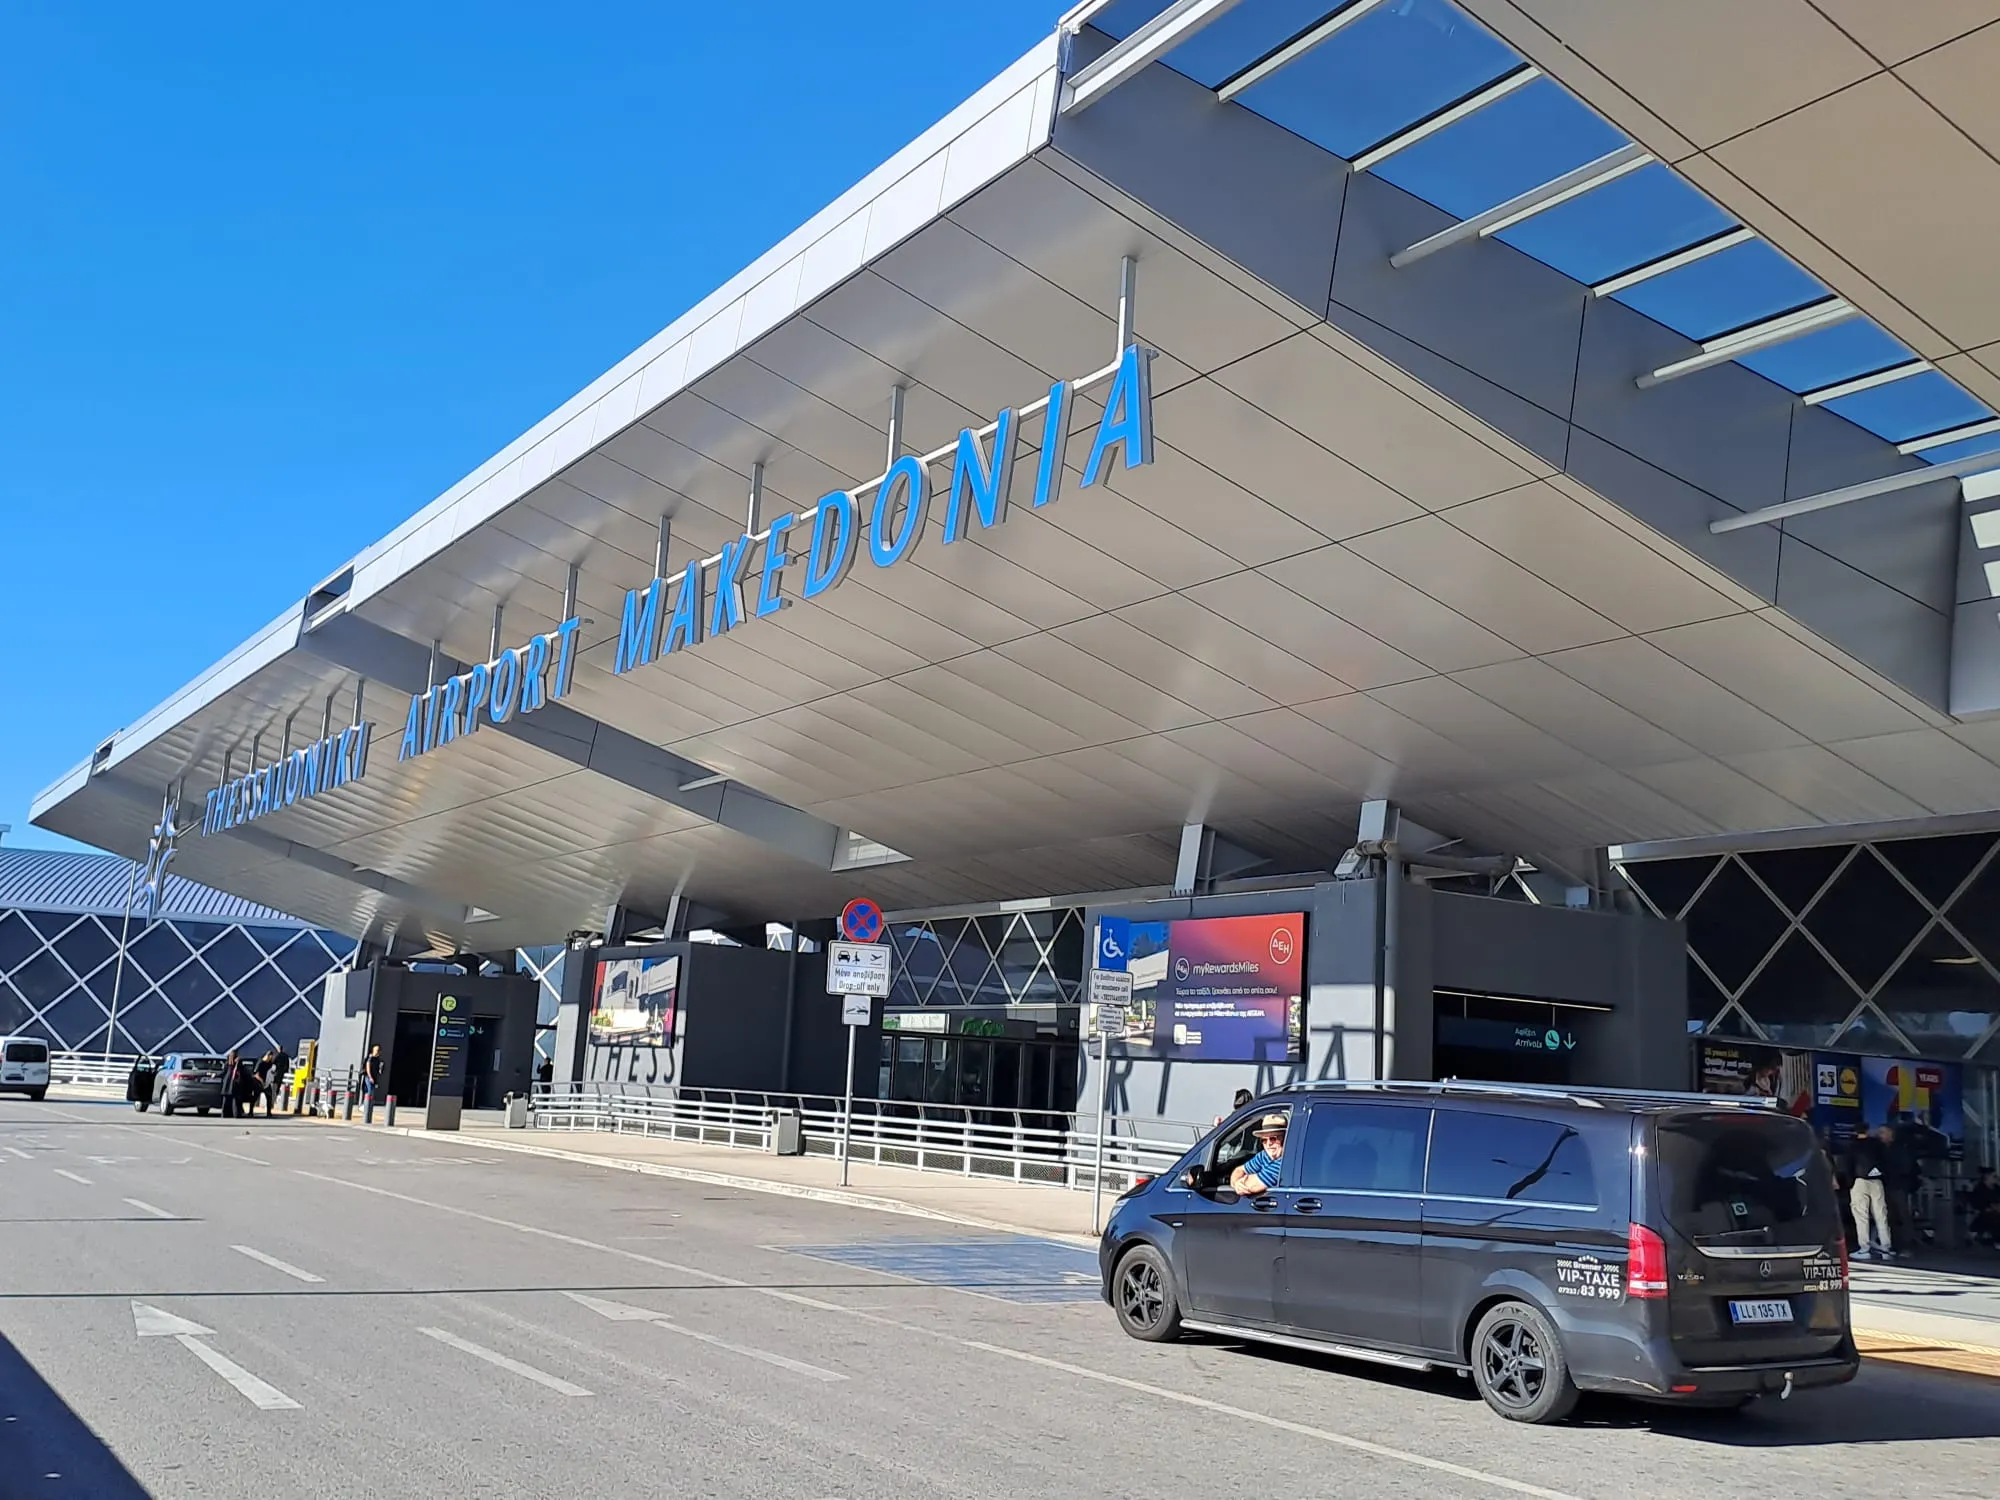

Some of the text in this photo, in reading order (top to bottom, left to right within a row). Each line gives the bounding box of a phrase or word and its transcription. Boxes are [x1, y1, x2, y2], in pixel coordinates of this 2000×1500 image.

[203, 344, 1152, 838] THESSALONIKI AIRPORT MAKEDONIA
[1272, 937, 1289, 954] ΔΕΗ
[1192, 960, 1260, 976] myRewardsMiles
[838, 980, 881, 992] Drop-off only
[1515, 1038, 1543, 1049] Arrivals
[1557, 1268, 1620, 1287] VIP-TAXE
[1803, 1265, 1842, 1279] VIP-TAXE
[1598, 1286, 1620, 1300] 999
[1740, 1304, 1753, 1318] LL
